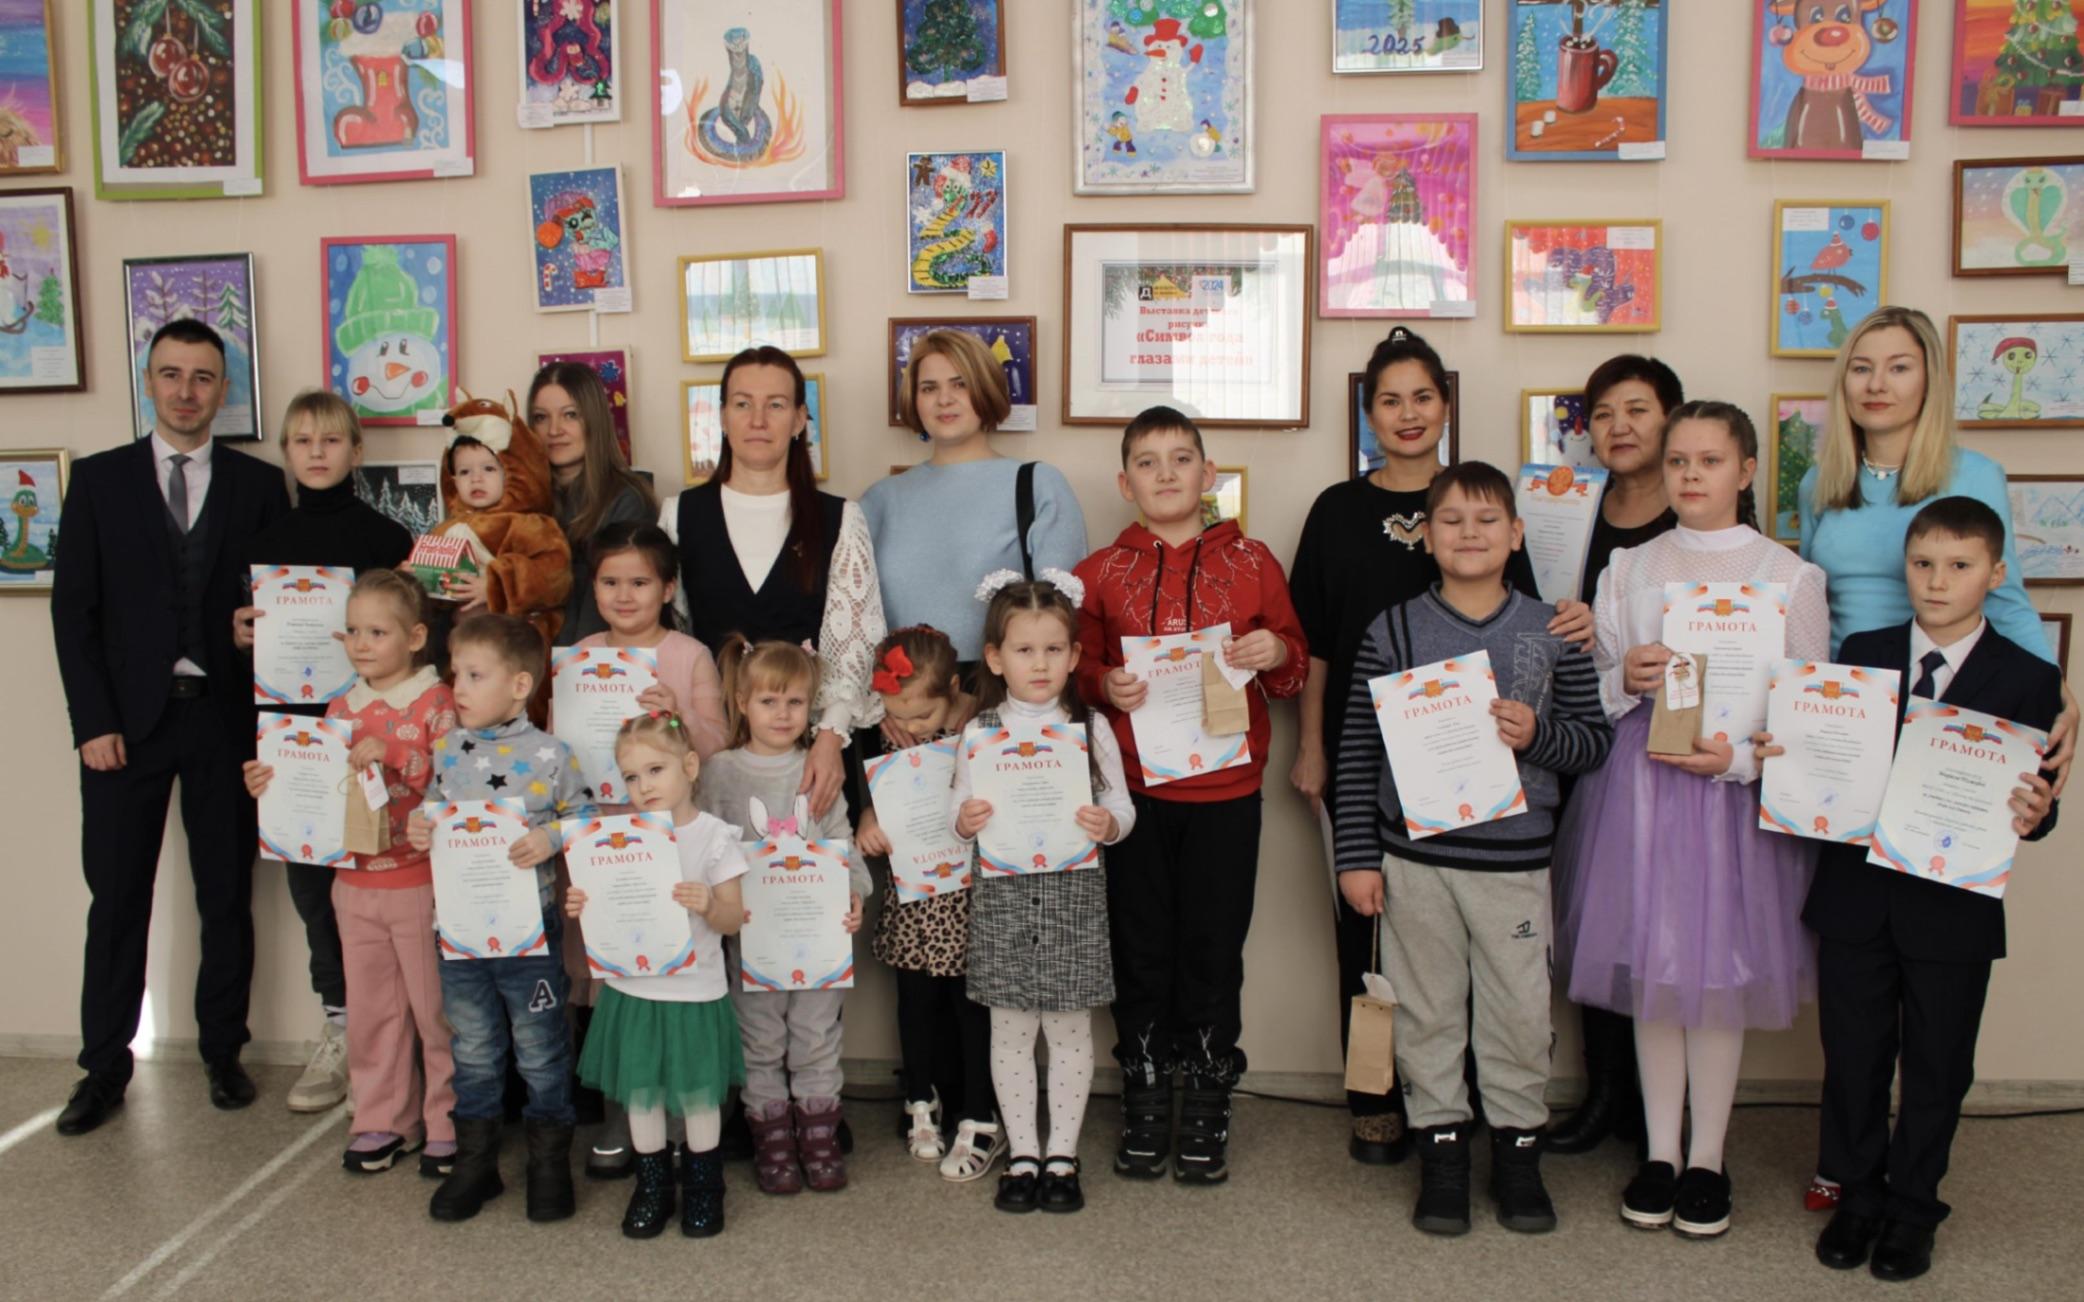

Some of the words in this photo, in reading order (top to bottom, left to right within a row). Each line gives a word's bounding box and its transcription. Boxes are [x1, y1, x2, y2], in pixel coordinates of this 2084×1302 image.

[1361, 33, 1425, 55] 2025
[1139, 306, 1191, 316] Выставка
[276, 596, 333, 605] ГРАМОТА
[1688, 621, 1758, 632] ГРАМОТА
[1148, 661, 1201, 678] ГРАМОТ
[575, 683, 634, 694] ГРАМОТА
[1403, 695, 1473, 720] ГРАМОТА
[1793, 700, 1867, 720] ГРАМОТА
[277, 749, 331, 763] ГРАМОТА
[1930, 737, 2007, 765] ГРАМОТА
[995, 759, 1063, 772] ГРАМОТА
[448, 836, 507, 849] ГРАМОТА
[591, 852, 654, 866] ГРАМОТА
[761, 875, 825, 885] ГРАМОТА
[529, 979, 556, 1013] A
